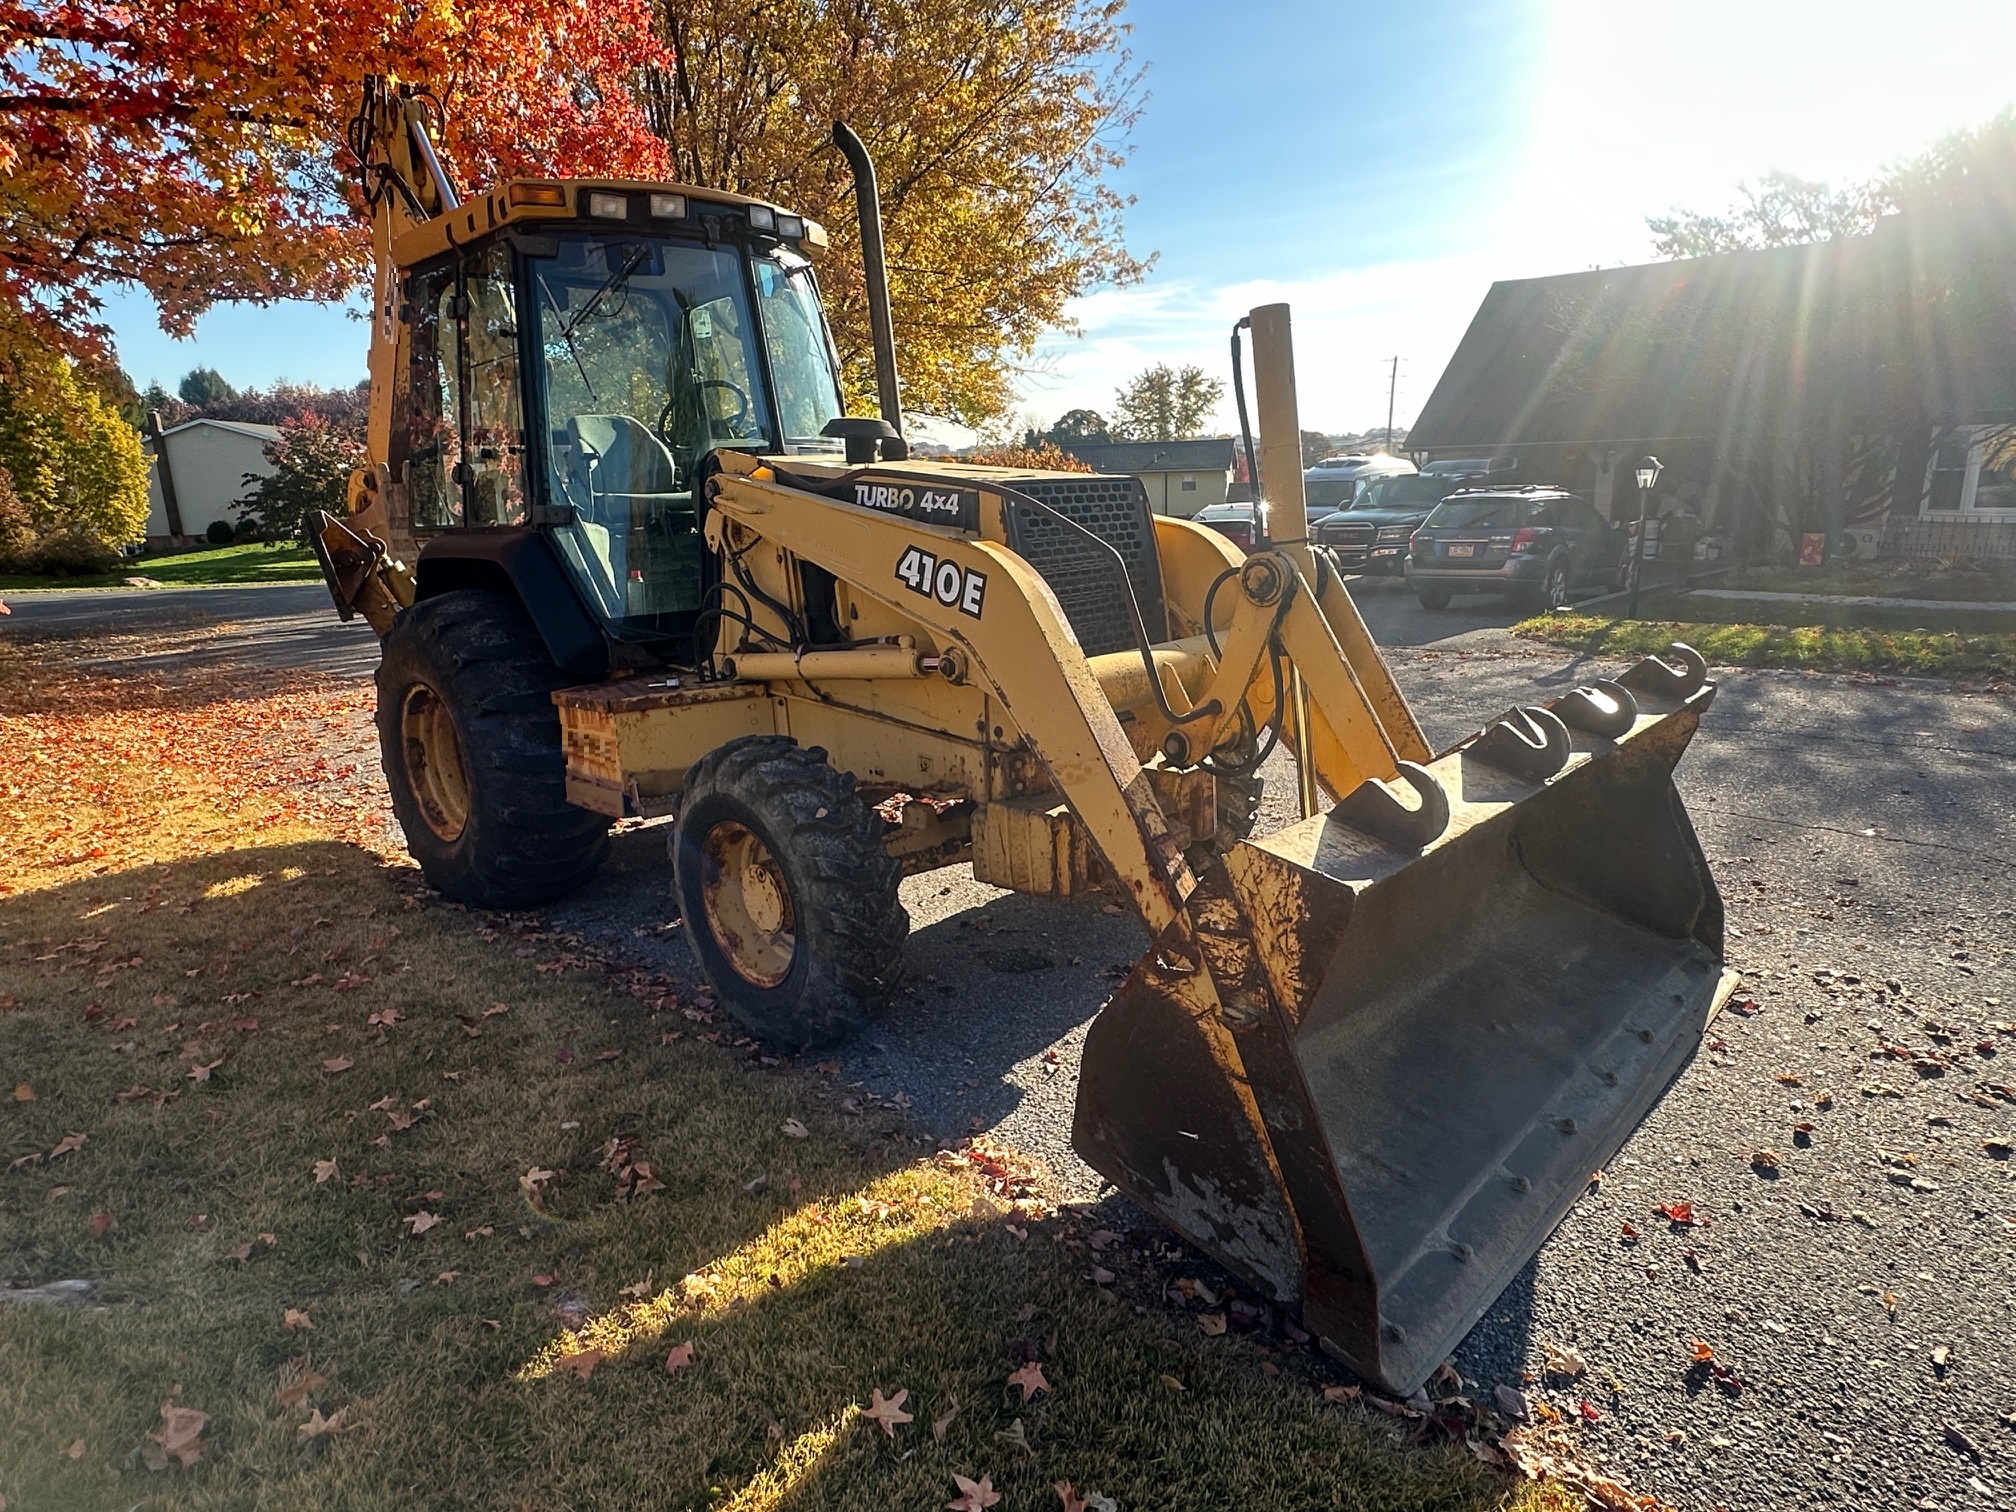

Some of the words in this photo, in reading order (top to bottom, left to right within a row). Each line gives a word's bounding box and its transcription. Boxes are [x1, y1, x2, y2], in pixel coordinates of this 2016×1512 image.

[855, 485, 915, 510] TURBO
[920, 491, 959, 516] 4x4
[897, 547, 986, 617] 410E
